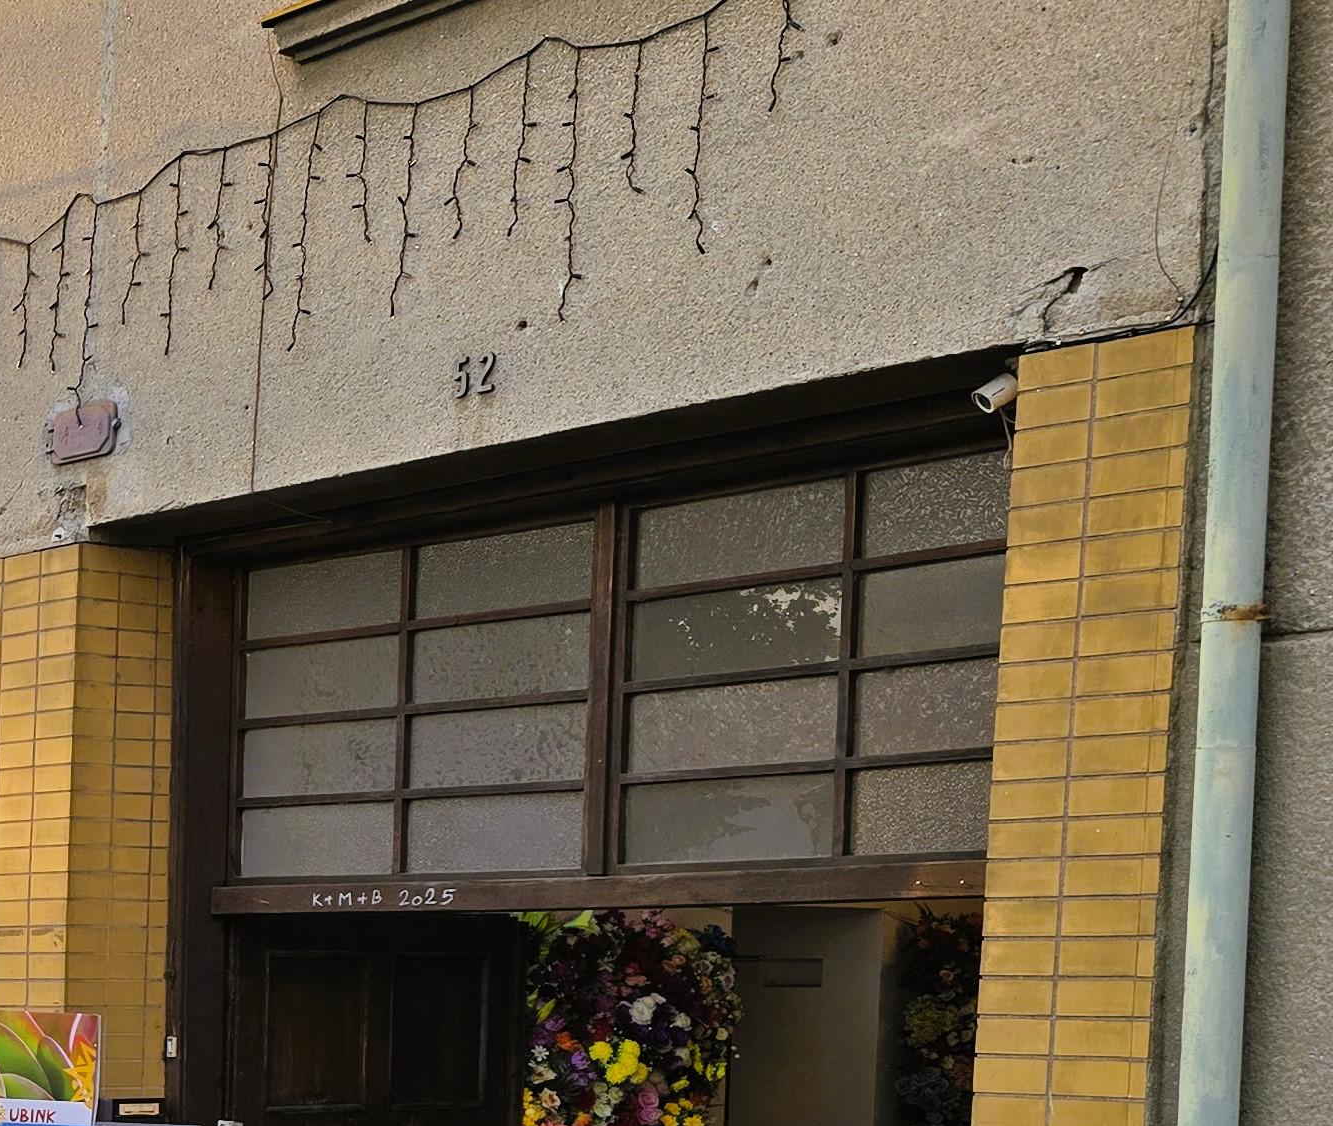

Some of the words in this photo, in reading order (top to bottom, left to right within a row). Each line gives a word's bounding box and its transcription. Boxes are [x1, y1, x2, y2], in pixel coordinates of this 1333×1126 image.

[453, 351, 497, 399] 52
[398, 887, 457, 907] 2025
[9, 1108, 57, 1124] UBINK
